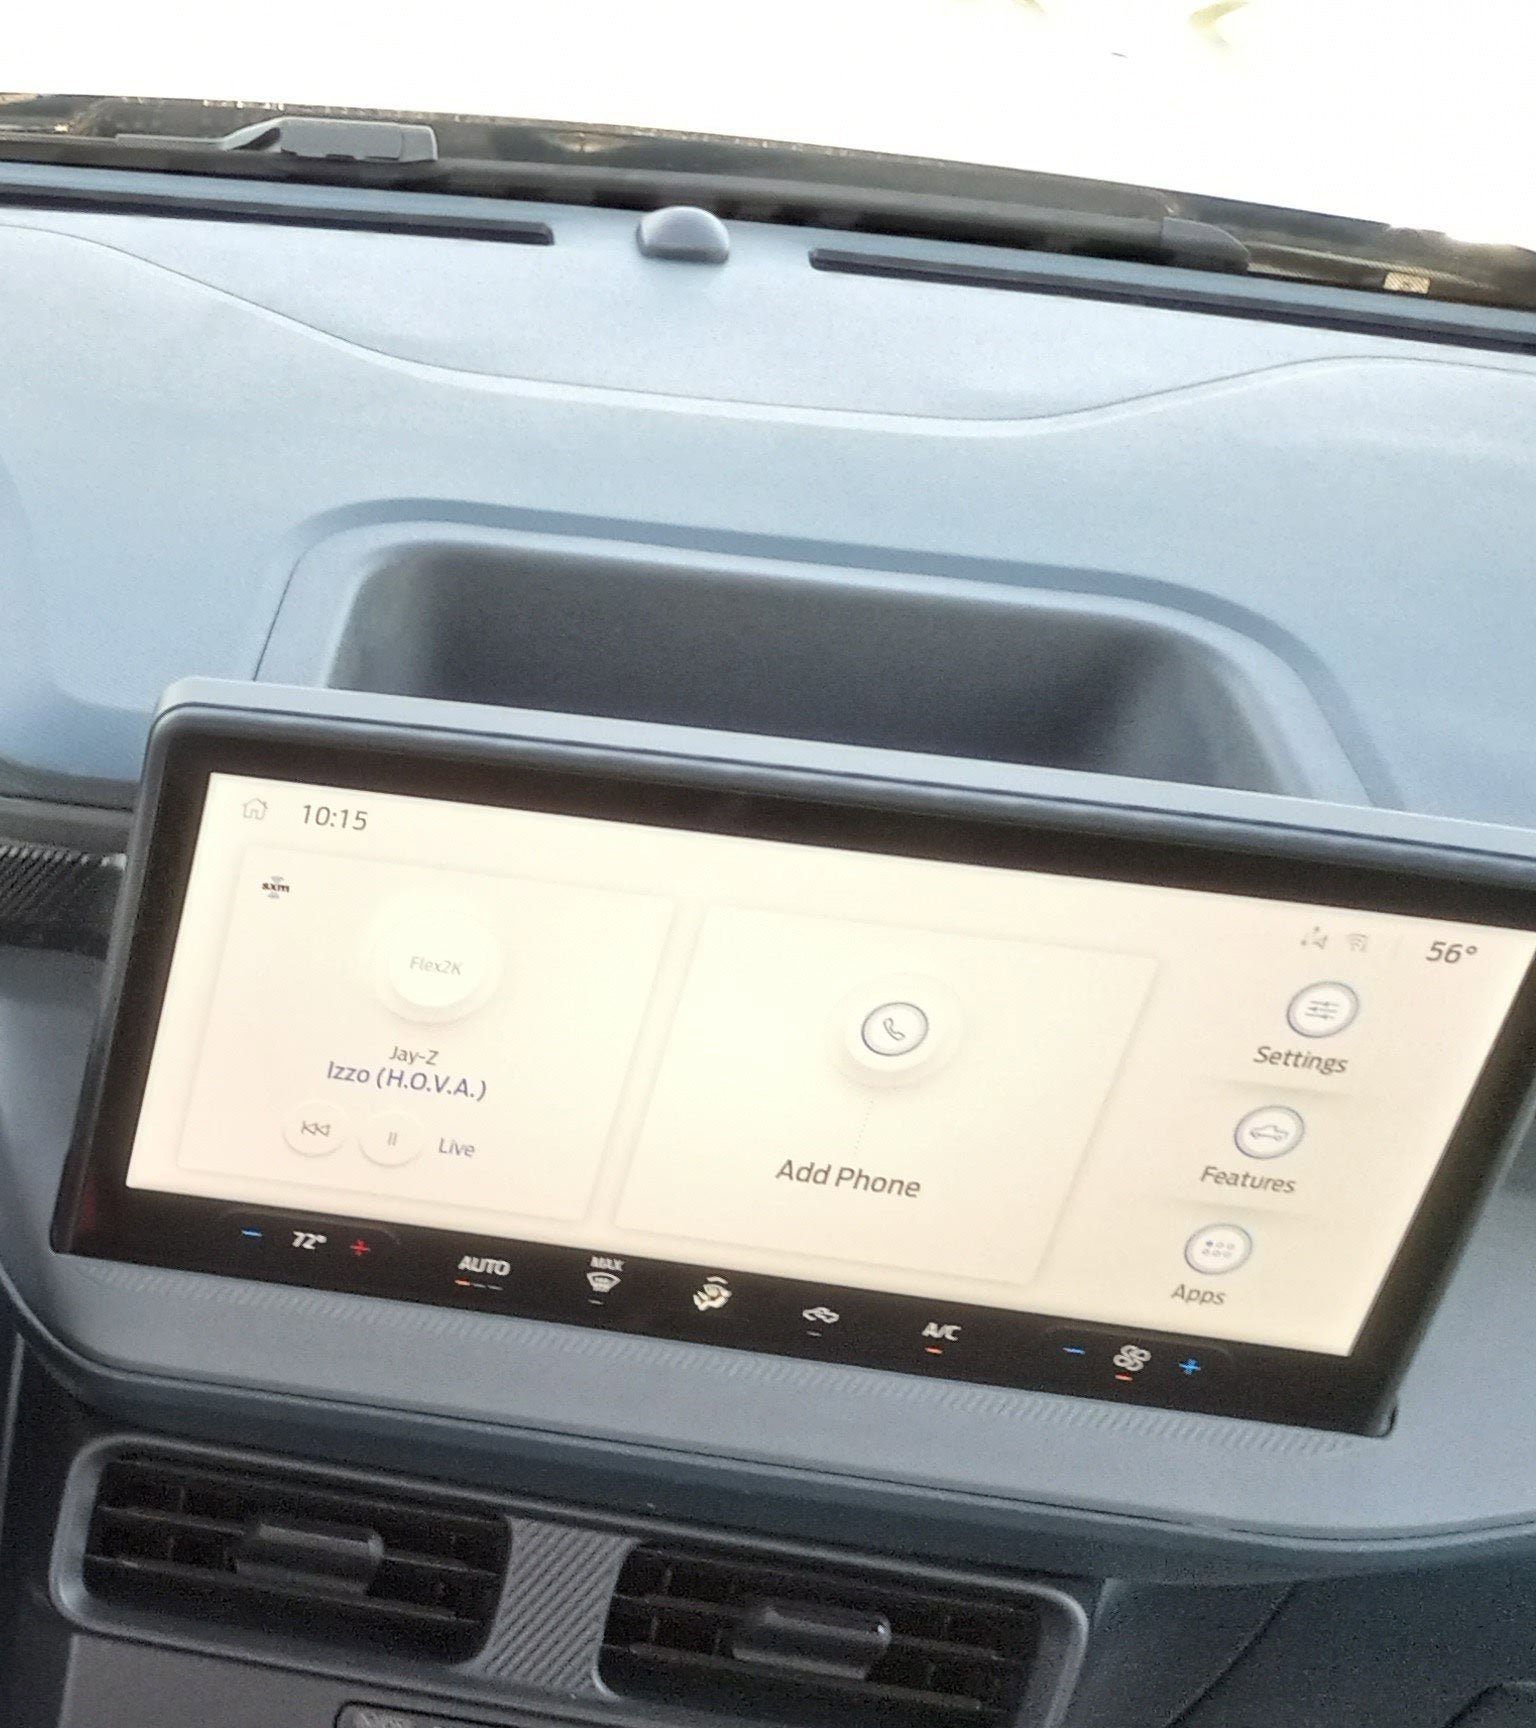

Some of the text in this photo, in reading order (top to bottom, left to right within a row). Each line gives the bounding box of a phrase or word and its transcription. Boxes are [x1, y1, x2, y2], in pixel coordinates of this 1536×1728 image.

[302, 804, 369, 832] 10:15
[1425, 940, 1478, 964] 56°
[388, 1045, 439, 1066] Jay-Z
[1253, 1045, 1349, 1076] Settings
[327, 1061, 487, 1102] Izzo (H.O.V.A.)
[438, 1137, 476, 1158] Live
[775, 1158, 922, 1198] Add Phone
[1199, 1165, 1297, 1195] Features
[457, 1254, 512, 1277] AUTO
[590, 1255, 626, 1272] MAX
[1171, 1283, 1227, 1306] Apps
[922, 1320, 962, 1343] A/C
